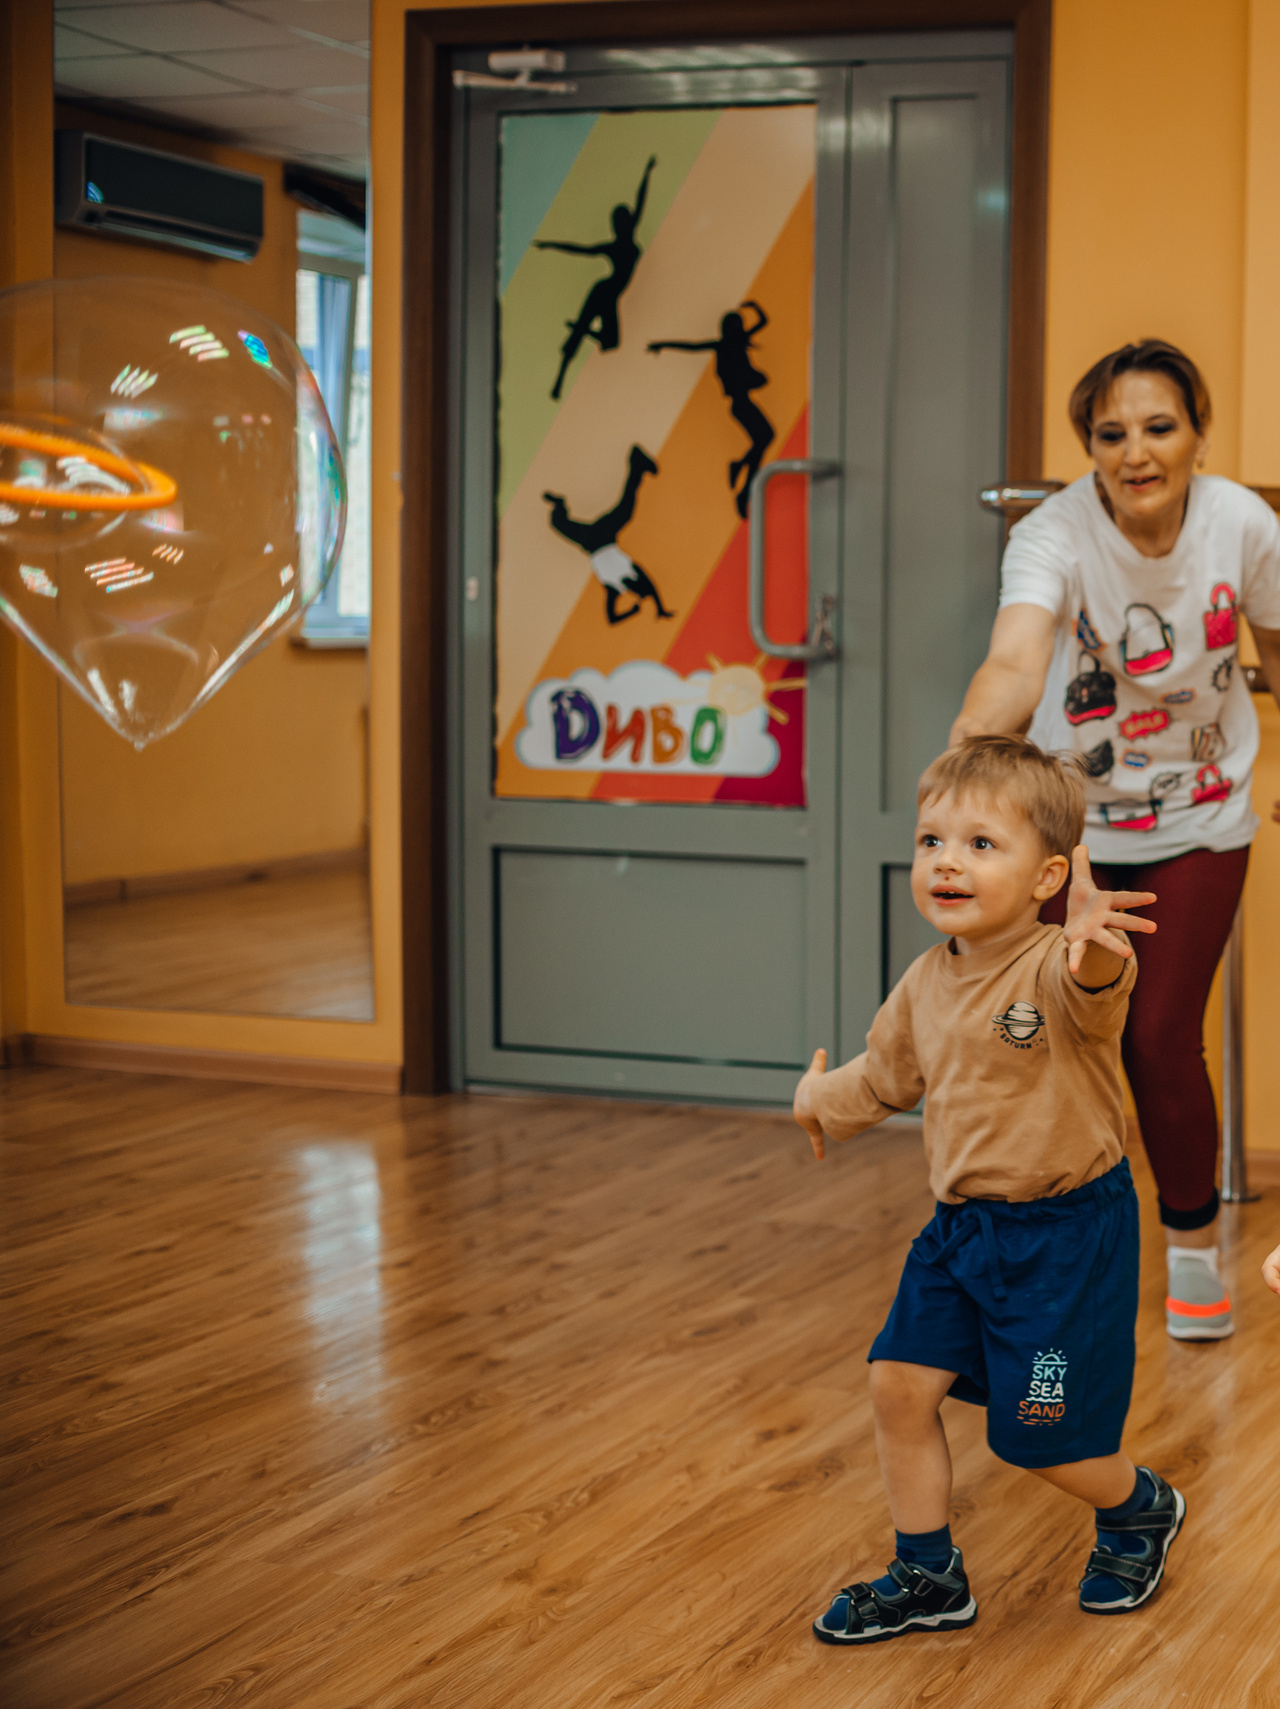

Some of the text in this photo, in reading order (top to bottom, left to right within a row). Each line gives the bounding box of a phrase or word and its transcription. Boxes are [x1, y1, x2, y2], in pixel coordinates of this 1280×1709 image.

[1032, 1365, 1067, 1381] SKY
[1029, 1380, 1064, 1397] SEA
[1018, 1401, 1066, 1418] SAND
